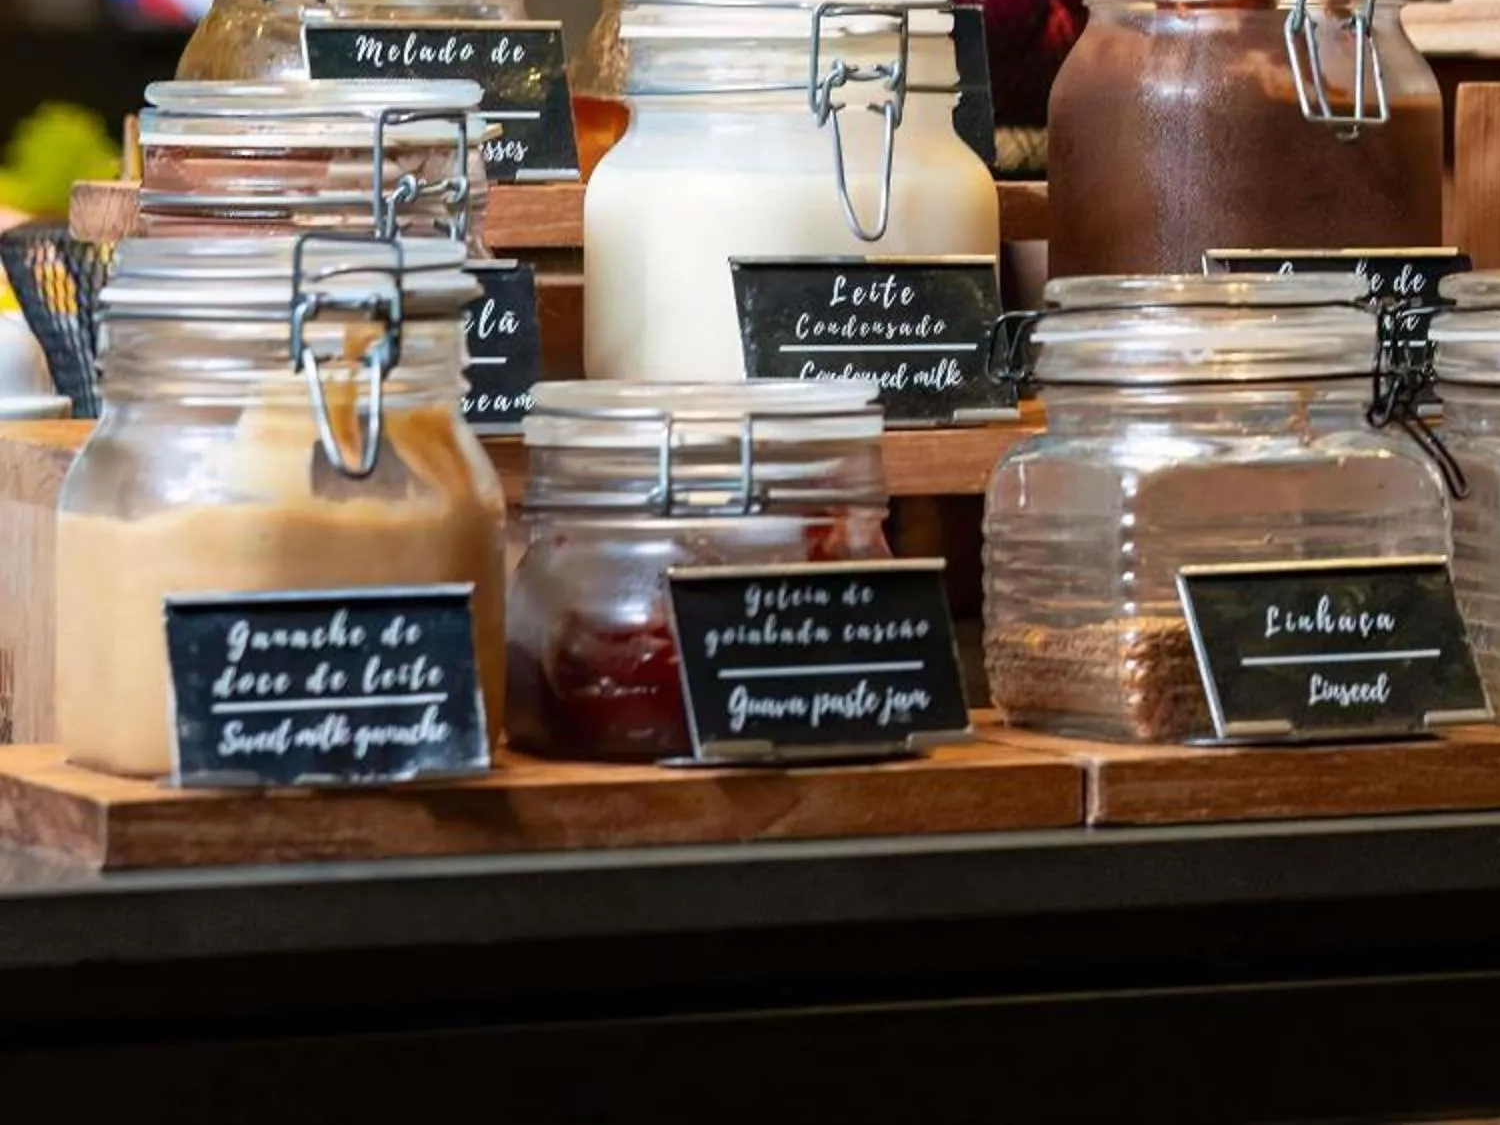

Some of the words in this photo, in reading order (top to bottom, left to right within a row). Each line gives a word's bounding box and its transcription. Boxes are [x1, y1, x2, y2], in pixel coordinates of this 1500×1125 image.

[355, 32, 475, 68] Melado
[491, 36, 526, 64] de
[483, 140, 529, 163] sses
[829, 274, 916, 309] Leite
[1393, 263, 1427, 295] de
[795, 312, 948, 340] Condensado
[913, 357, 964, 391] milk
[461, 392, 536, 414] ream
[1264, 594, 1396, 638] Linhaça
[227, 607, 367, 663] Ganache
[380, 615, 423, 648] de
[211, 665, 292, 699] doce
[305, 661, 348, 694] de
[362, 655, 446, 694] leite
[1308, 672, 1392, 707] Linseed
[728, 684, 808, 733] Guava
[810, 679, 882, 727] paste
[877, 685, 932, 726] jam
[294, 712, 352, 752] milk
[353, 705, 450, 760] ganache
